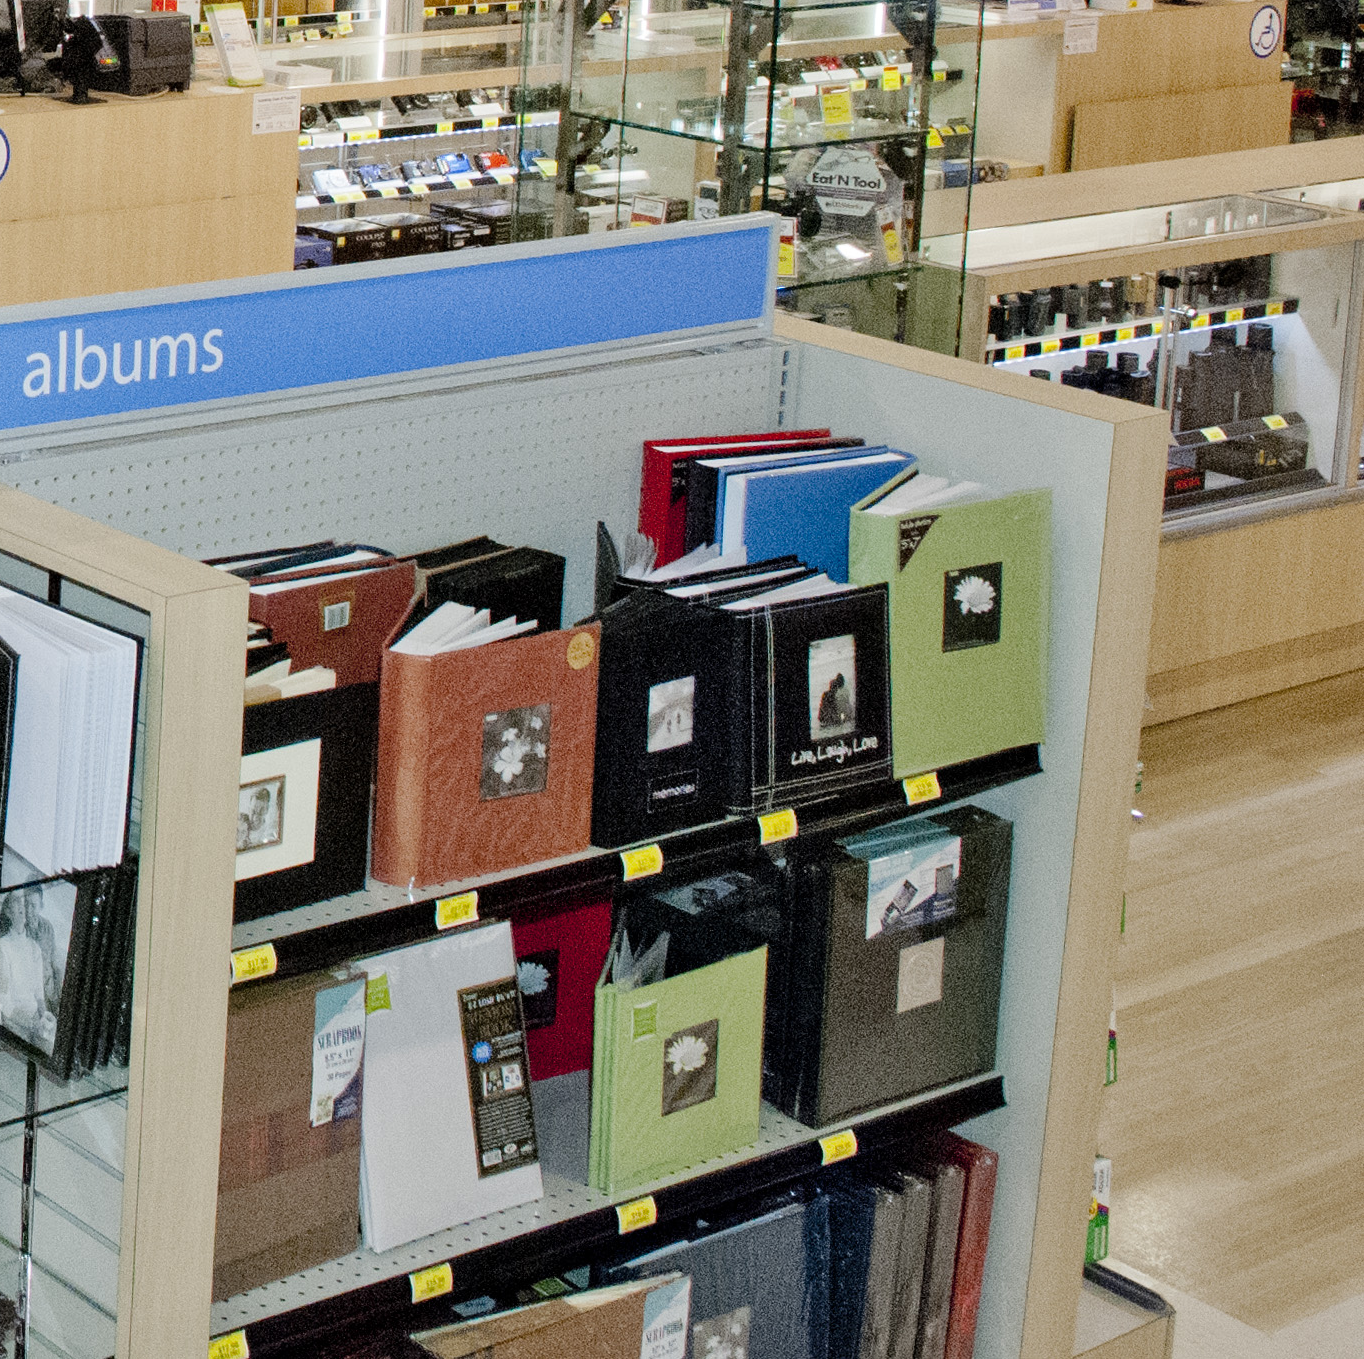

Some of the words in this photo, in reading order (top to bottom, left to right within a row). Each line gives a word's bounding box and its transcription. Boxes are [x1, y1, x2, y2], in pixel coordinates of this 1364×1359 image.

[852, 176, 881, 189] Tool
[21, 328, 225, 399] albums
[316, 1024, 363, 1050] SCRAPBOOK
